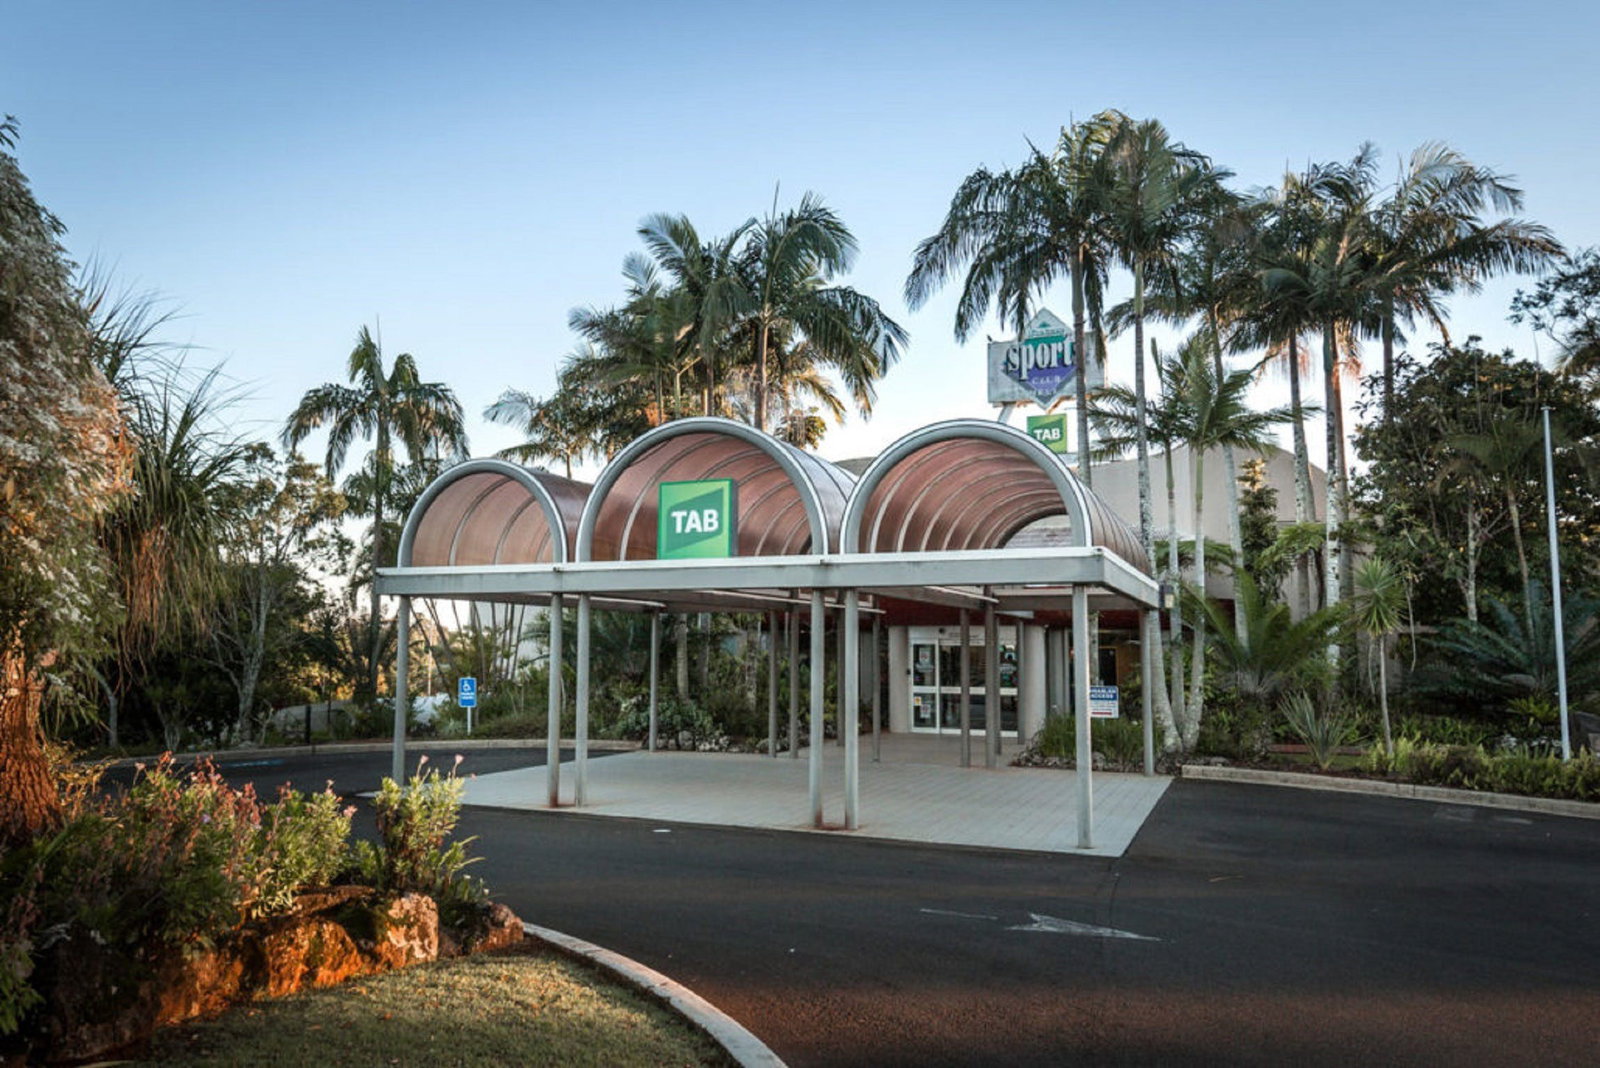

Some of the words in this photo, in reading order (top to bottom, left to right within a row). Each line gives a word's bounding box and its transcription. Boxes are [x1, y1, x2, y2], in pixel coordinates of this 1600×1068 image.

[1006, 335, 1078, 380] sport
[1033, 428, 1061, 440] TAB
[671, 509, 719, 534] TAB
